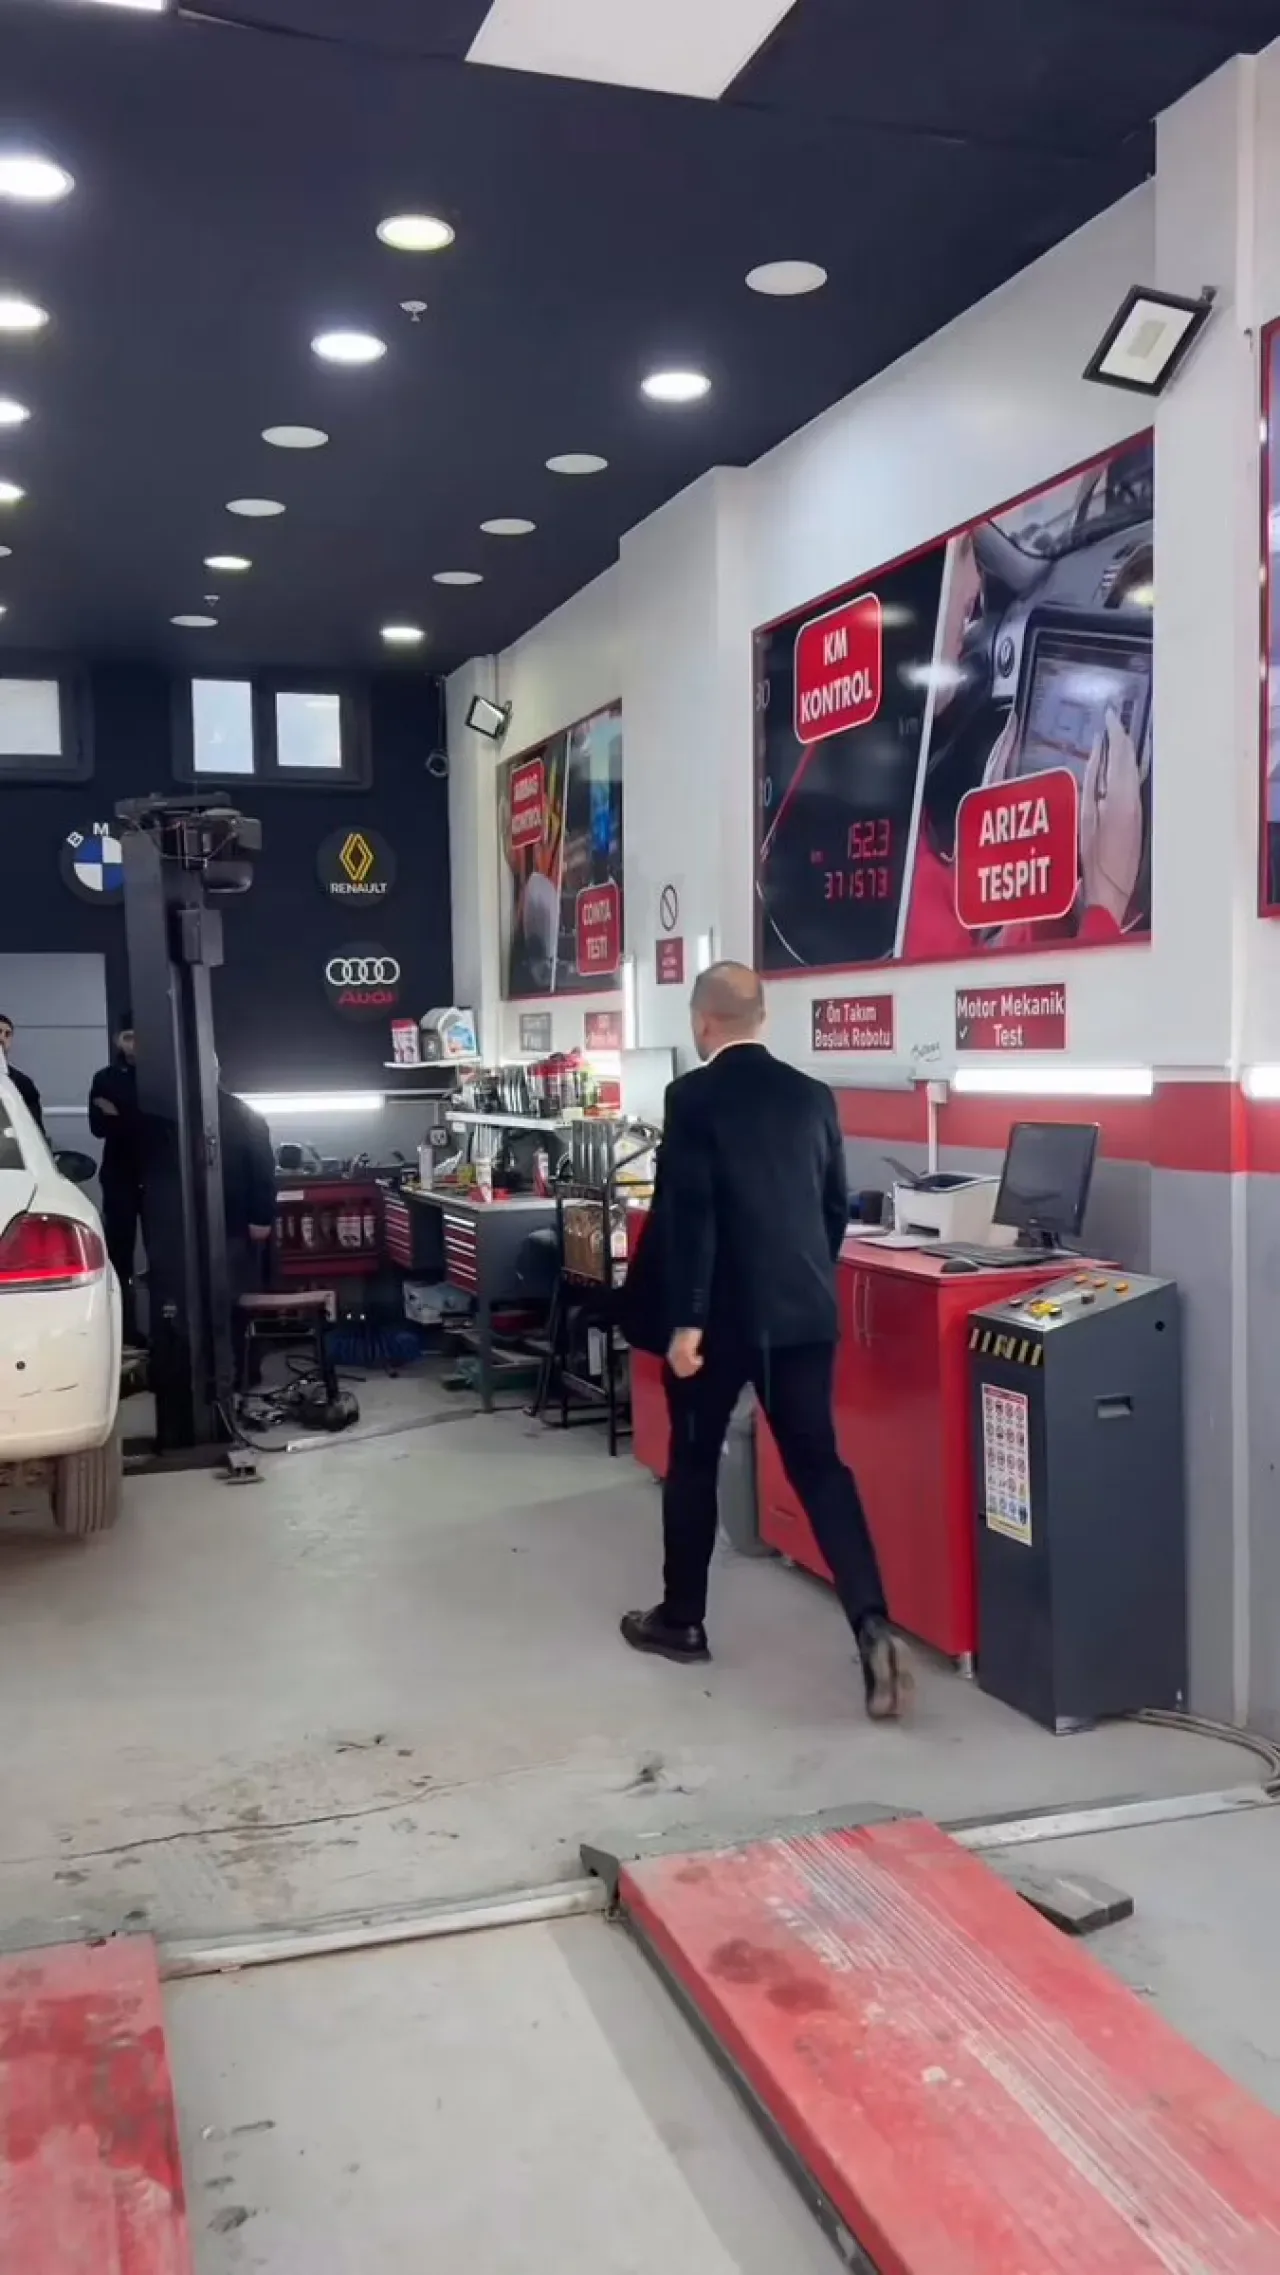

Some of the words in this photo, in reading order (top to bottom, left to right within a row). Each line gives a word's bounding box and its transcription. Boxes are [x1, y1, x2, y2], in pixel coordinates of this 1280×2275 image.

[822, 626, 849, 667] KM
[800, 667, 873, 724] KONTROL
[978, 797, 1050, 848] ARIZA
[331, 883, 387, 894] RENAULT
[977, 846, 1051, 904] TESPİT
[826, 1000, 842, 1024] Ön
[844, 1003, 877, 1022] Takım
[956, 996, 997, 1019] Motor
[1000, 990, 1066, 1018] Mekanik
[814, 1029, 850, 1048] Boşluk
[852, 1028, 892, 1048] Robotu
[993, 1024, 1024, 1048] Test
